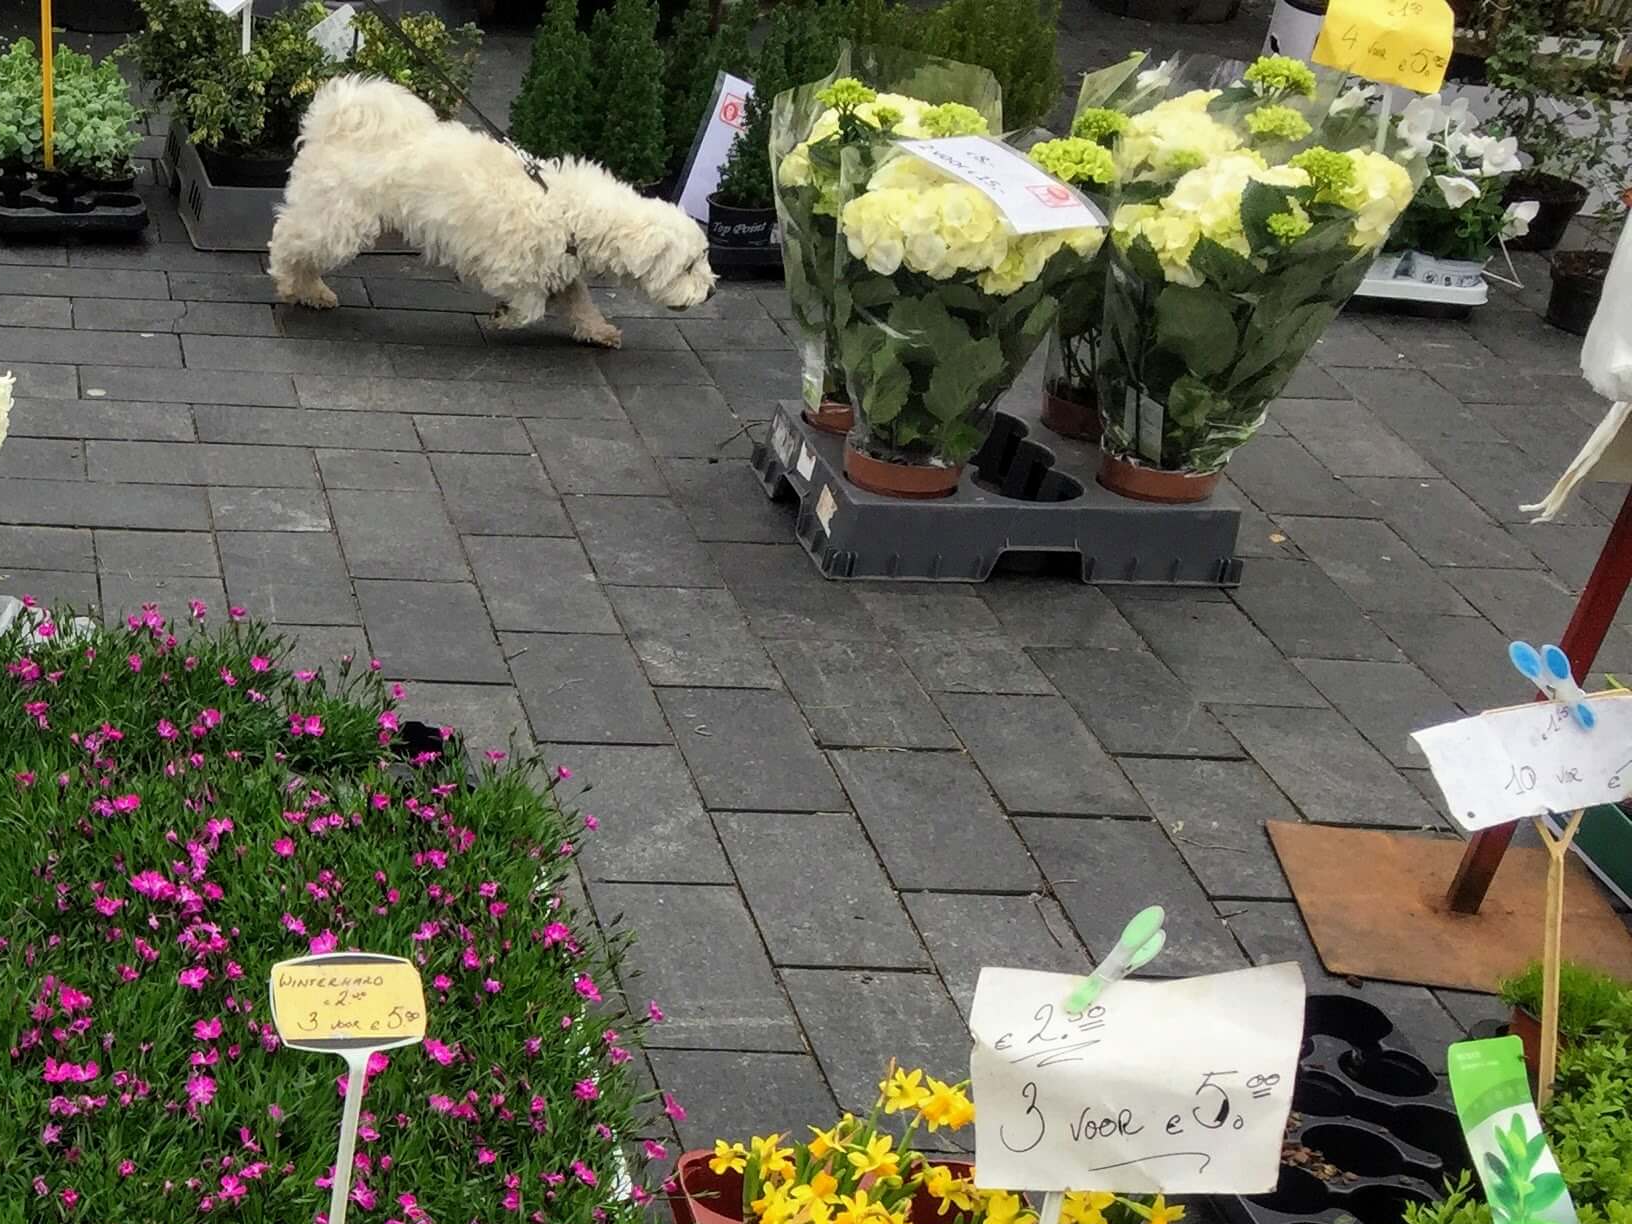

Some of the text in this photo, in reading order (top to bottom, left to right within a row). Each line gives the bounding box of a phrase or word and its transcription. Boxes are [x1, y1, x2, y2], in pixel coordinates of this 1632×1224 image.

[297, 1011, 319, 1032] 3
[1000, 1081, 1046, 1153] 3
[1070, 1107, 1144, 1142] VOOR
